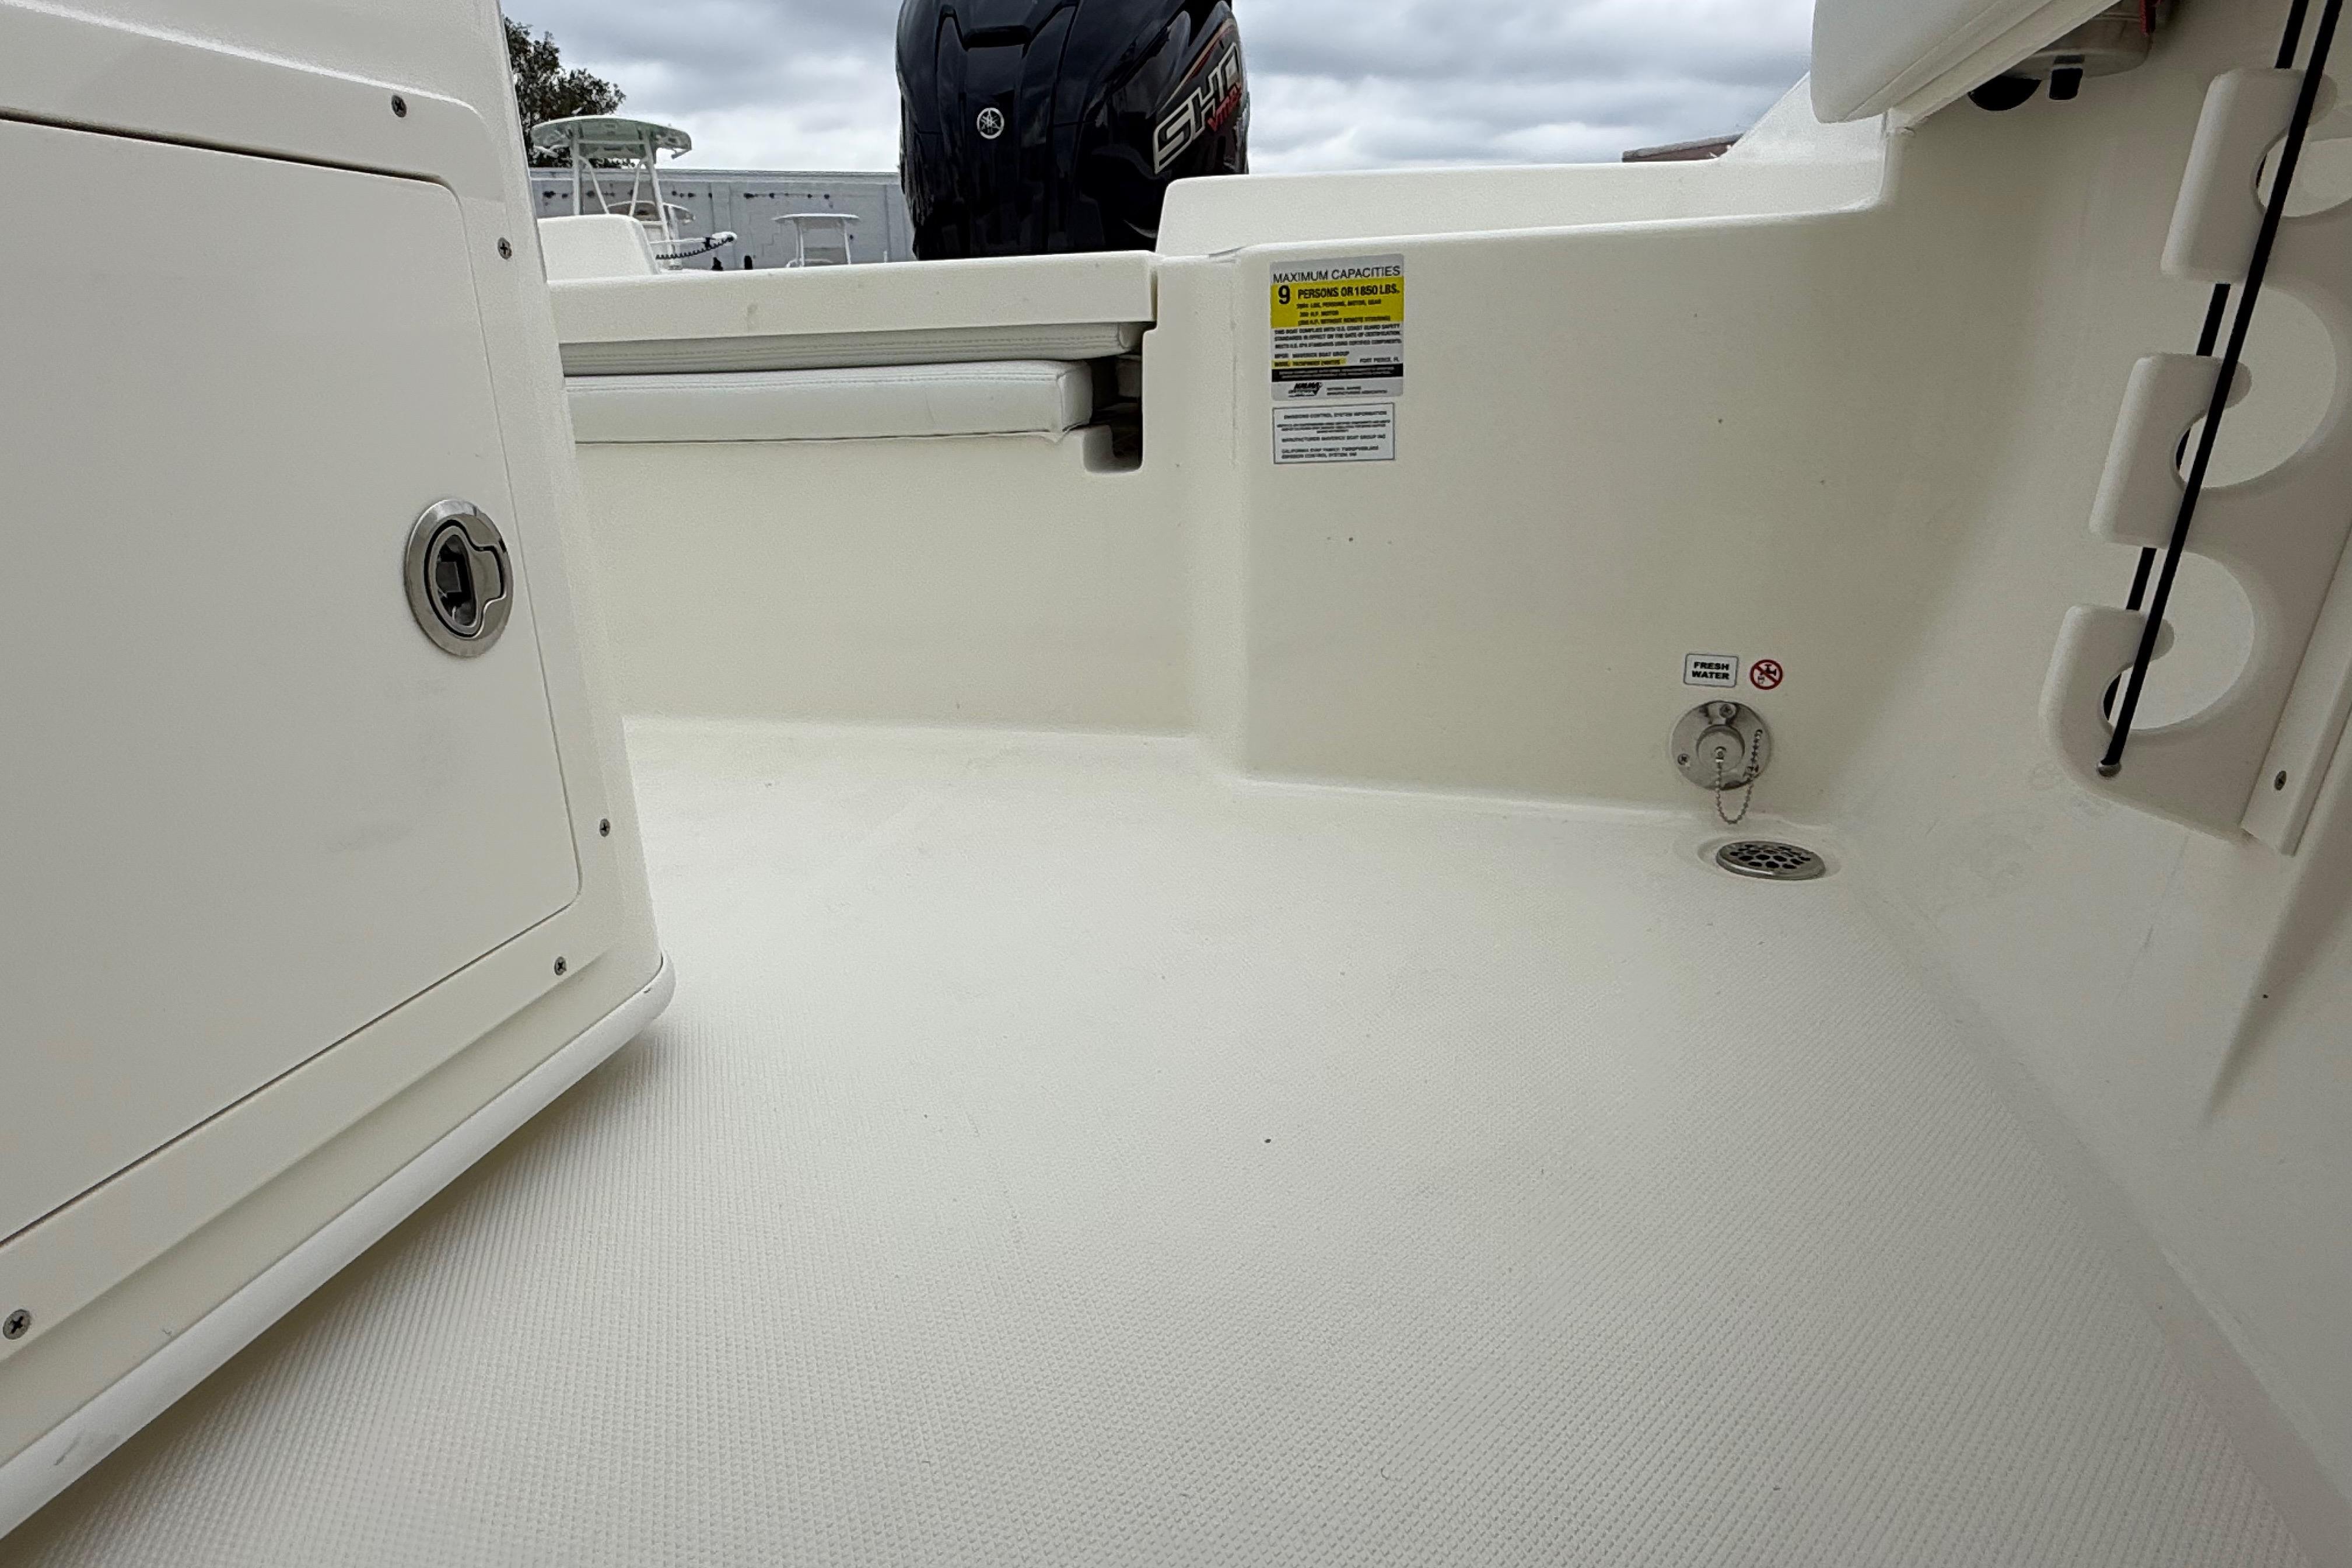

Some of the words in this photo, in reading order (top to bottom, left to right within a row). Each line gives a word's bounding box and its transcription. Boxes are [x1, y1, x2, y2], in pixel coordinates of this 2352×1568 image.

[1153, 42, 1241, 174] SHO
[1273, 270, 1328, 284] MAXIMUM
[1331, 265, 1401, 280] CAPACITIES
[1278, 285, 1290, 304] 9
[1297, 287, 1340, 299] PERSONS
[1341, 286, 1354, 296] OR
[1354, 285, 1378, 296] 1850
[1378, 283, 1400, 294] LBS.
[1694, 662, 1730, 670] FRESH
[1692, 671, 1730, 680] WATER
